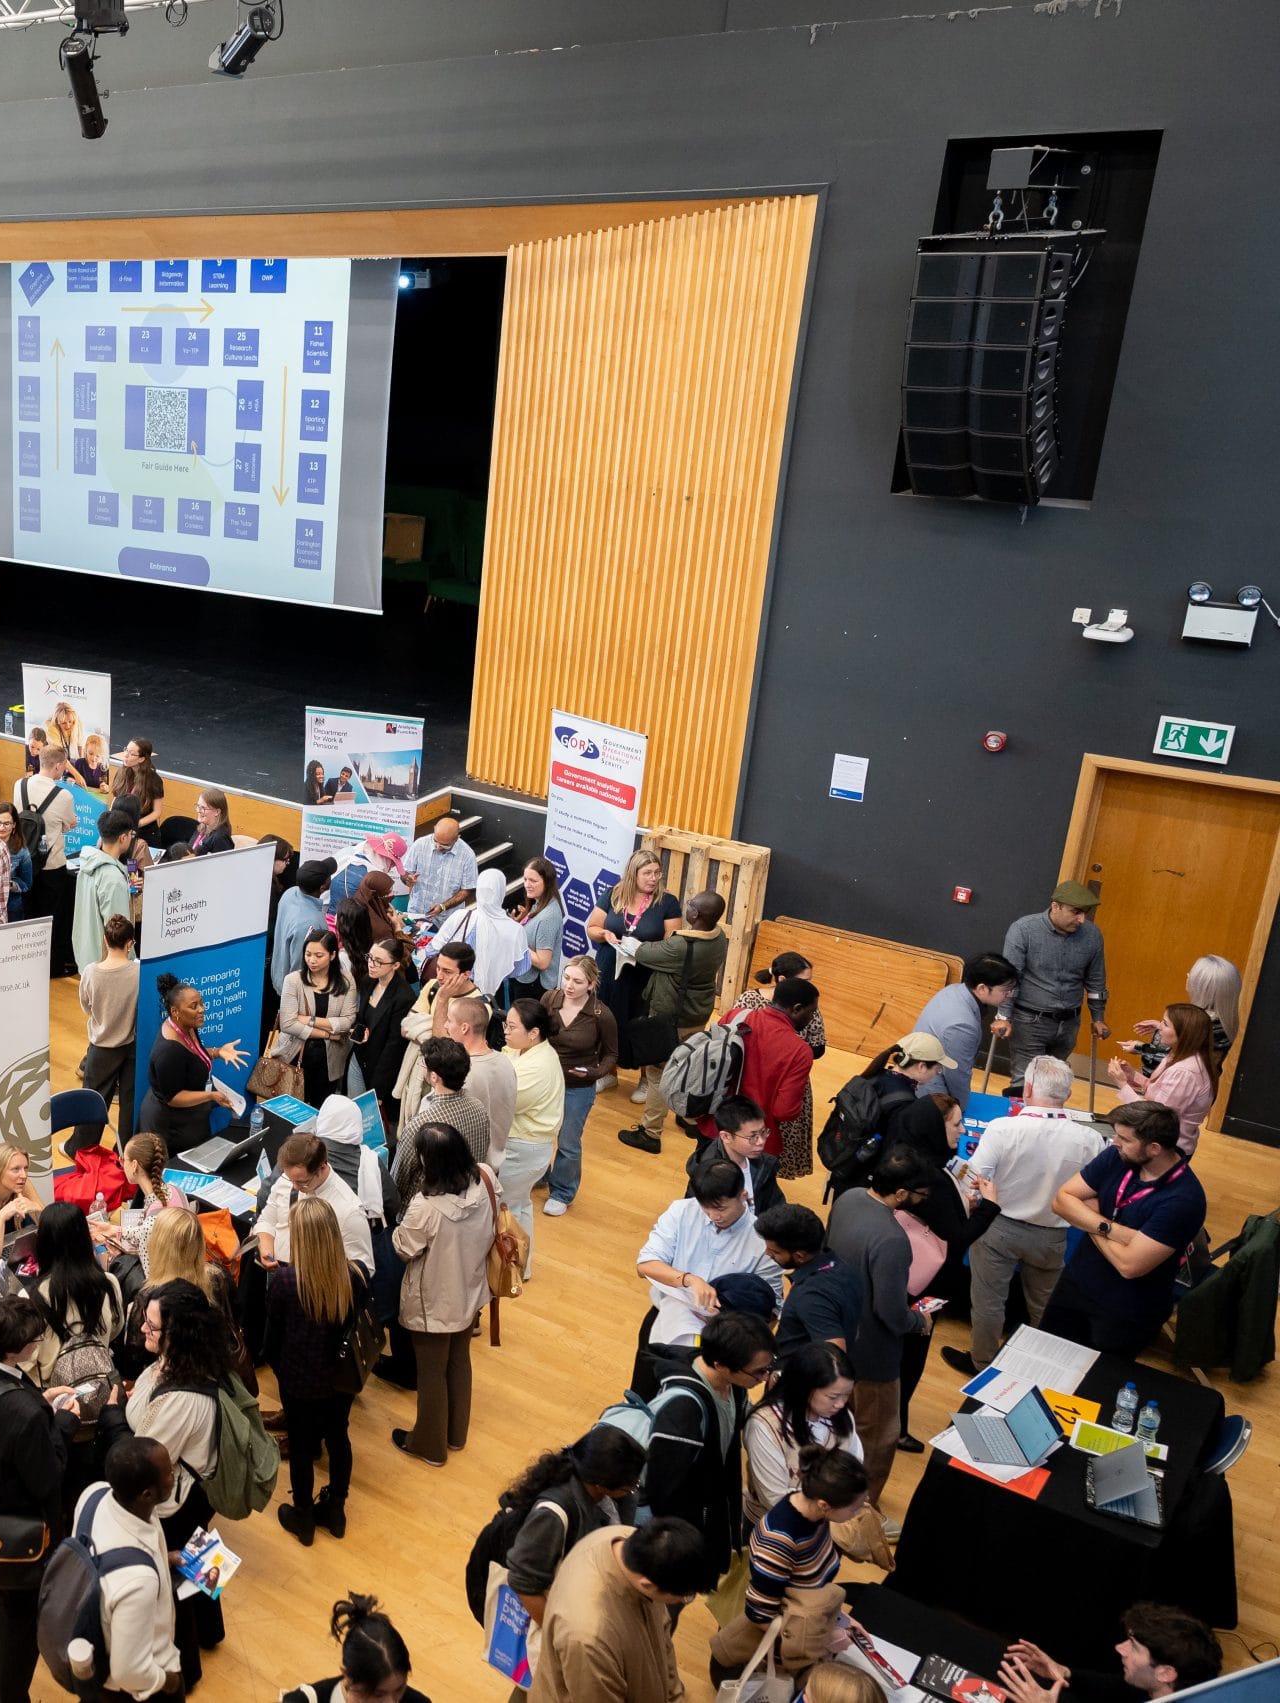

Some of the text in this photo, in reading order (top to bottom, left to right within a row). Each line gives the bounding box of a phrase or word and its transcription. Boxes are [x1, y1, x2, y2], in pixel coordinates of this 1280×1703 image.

[98, 328, 105, 336] 22
[141, 331, 150, 339] 23
[188, 332, 197, 341] 24
[237, 332, 246, 341] 25
[313, 327, 323, 336] 11
[229, 344, 253, 352] Research
[311, 400, 320, 408] 12
[142, 462, 189, 474] Fair Guide Here
[309, 462, 318, 471] 13
[191, 502, 200, 510] 16
[237, 507, 246, 516] 15
[304, 528, 313, 537] 14
[150, 562, 176, 573] Entrance
[62, 684, 85, 695] STEM
[313, 727, 348, 738] Department
[322, 736, 337, 744] Work
[561, 734, 595, 754] GORS
[313, 741, 339, 750] Pensions
[603, 738, 642, 755] GOVERNMENT
[563, 769, 621, 794] Government analytical
[556, 776, 627, 805] careers available nationwide
[75, 804, 92, 814] with
[82, 816, 95, 826] the
[166, 899, 207, 917] UK Health
[165, 913, 199, 927] Security
[16, 931, 30, 941] Open
[165, 925, 195, 938] Agency
[22, 949, 48, 962] publishing
[201, 967, 241, 986] preparing
[225, 979, 241, 991] and
[213, 990, 247, 1006] to health
[225, 1004, 242, 1017] lives
